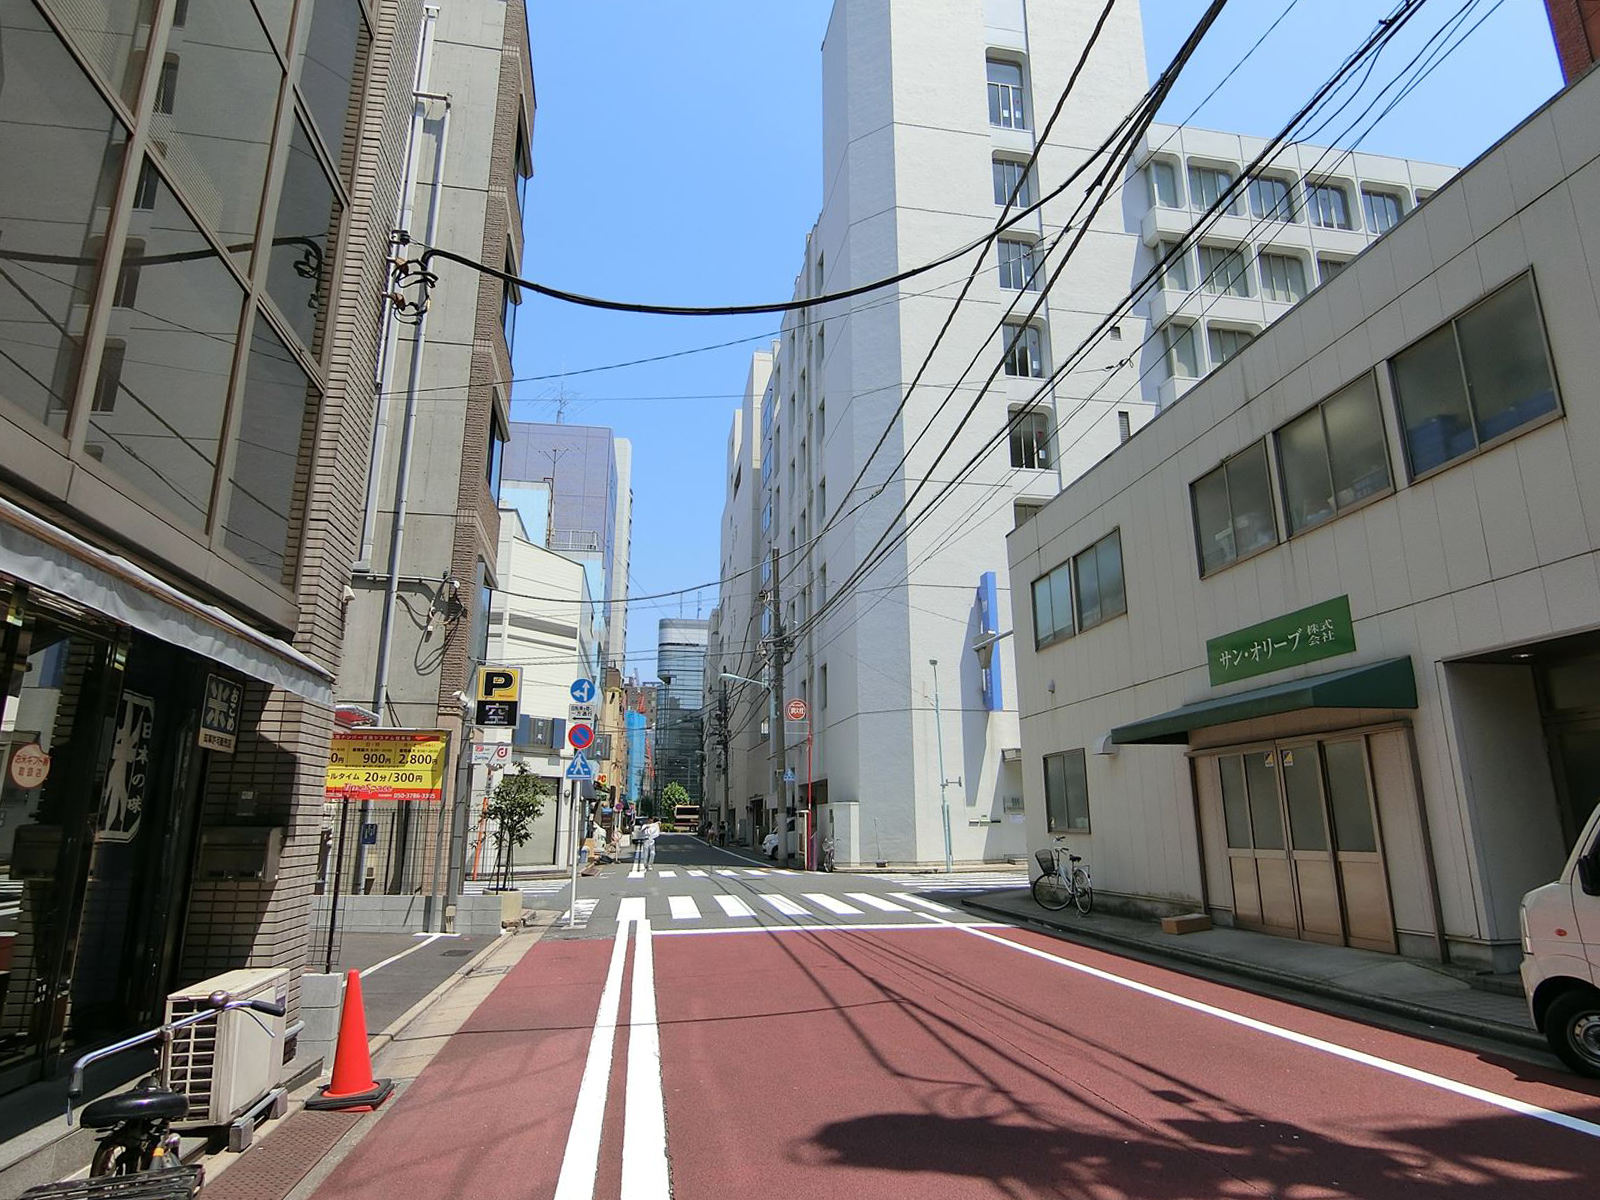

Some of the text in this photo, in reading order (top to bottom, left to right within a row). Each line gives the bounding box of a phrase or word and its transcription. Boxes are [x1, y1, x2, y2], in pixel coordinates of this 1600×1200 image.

[1307, 618, 1333, 635] 株式
[1309, 630, 1335, 646] 会社
[1220, 628, 1302, 670] サン・オリーブ
[484, 671, 514, 697] P
[226, 687, 240, 731] おこめ
[329, 752, 344, 763] 0円
[363, 753, 391, 764] 900円
[398, 754, 438, 765] 2,800円
[127, 722, 152, 813] 日本の味
